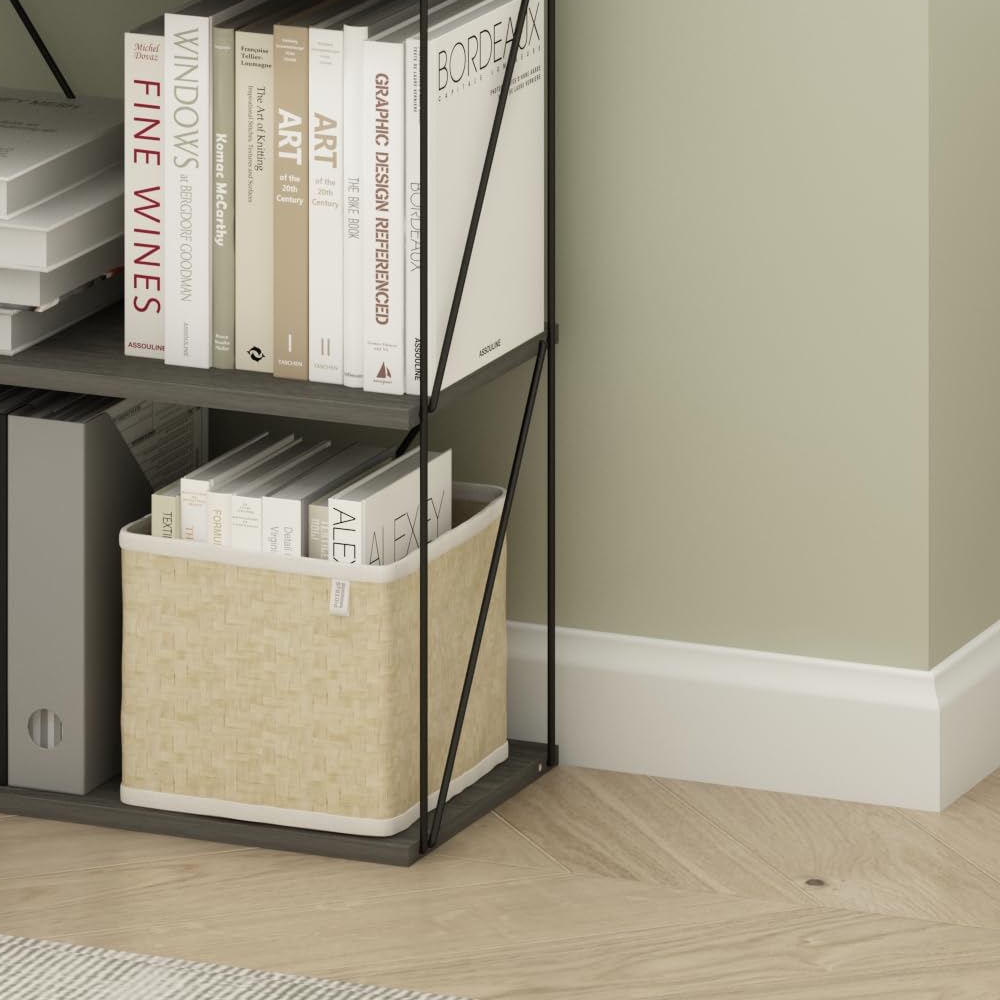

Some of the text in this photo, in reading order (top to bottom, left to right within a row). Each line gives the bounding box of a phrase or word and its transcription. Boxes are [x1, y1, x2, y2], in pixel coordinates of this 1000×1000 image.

[134, 42, 160, 52] Michel
[135, 52, 159, 61] Dovaz
[438, 2, 540, 91] BORDEAUX
[172, 27, 200, 170] WINDOWS
[374, 72, 390, 146] GRAPHIC
[254, 86, 266, 172] The Art of Knitting
[278, 108, 303, 166] ART
[314, 112, 338, 168] ART
[133, 79, 161, 314] FINE WINES
[276, 194, 304, 206] Century
[280, 174, 300, 182] of the
[282, 184, 298, 192] 20th
[312, 198, 338, 208] Century
[318, 188, 334, 196] 20th
[324, 178, 336, 186] the
[374, 152, 390, 212] DESIGN
[180, 185, 192, 242] BERGDORF
[214, 186, 228, 247] McCarthy
[347, 177, 360, 240] THE BIKE BOOK
[180, 244, 192, 302] GOODMAN
[374, 218, 390, 326] REFERENCED
[479, 338, 502, 358] ASSOULINE
[333, 508, 356, 564] ALE
